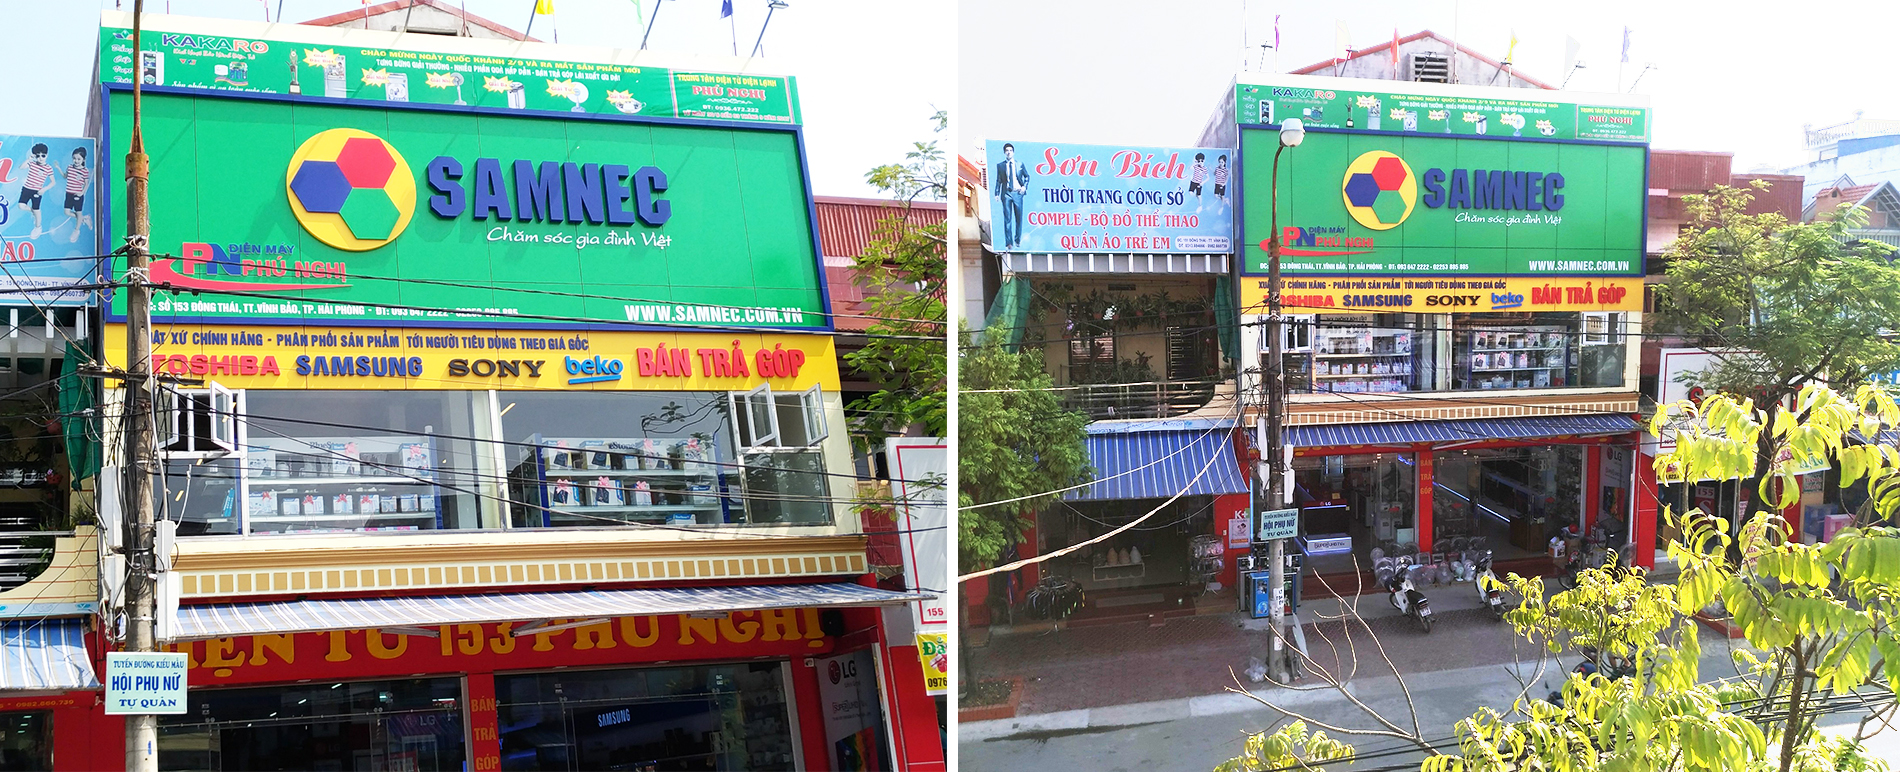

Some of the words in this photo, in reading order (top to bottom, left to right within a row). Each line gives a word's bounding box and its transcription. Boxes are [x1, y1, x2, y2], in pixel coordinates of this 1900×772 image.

[162, 34, 268, 53] KAKARO
[361, 49, 386, 57] CHÀO
[390, 50, 416, 59] MỪNG
[420, 52, 443, 61] NGÀY
[446, 53, 470, 62] QUỐC
[474, 56, 504, 64] KHÁNH
[508, 58, 523, 66] 2/9
[526, 58, 537, 66] VÀ
[555, 61, 574, 69] MẮT
[577, 62, 594, 71] SẢN
[597, 64, 621, 72] PHẨM
[624, 66, 641, 74] MỚI
[692, 84, 723, 96] PHÚ
[727, 87, 766, 101] NGHỊ
[1272, 87, 1336, 100] KAKARO
[715, 105, 759, 113] 0936.472.222
[1609, 117, 1632, 125] NGHỊ
[1036, 147, 1100, 176] Sơn
[1111, 150, 1187, 180] Bích
[428, 156, 672, 227] SAMNEC
[1042, 185, 1074, 203] THỜI
[1078, 189, 1122, 204] TRANG
[1127, 187, 1162, 205] CÔNG
[1166, 187, 1184, 205] SỞ
[1424, 168, 1564, 211] SAMNEC
[1028, 212, 1081, 226] COMPLE
[1090, 211, 1109, 229] BỘ
[1112, 210, 1131, 227] ĐỒ
[1136, 209, 1160, 227] THỂ
[1163, 214, 1199, 228] THAO
[1455, 212, 1485, 223] Chăm
[1488, 215, 1504, 224] sóc
[1506, 216, 1520, 226] gia
[1522, 215, 1541, 224] đình
[1544, 215, 1562, 226] Việt
[487, 227, 539, 243] Chăm
[543, 230, 573, 245] sóc
[577, 233, 599, 250] gia
[603, 231, 636, 246] đình
[640, 232, 672, 250] Việt
[1283, 226, 1316, 247] PN
[1309, 226, 1327, 234] ĐIỆN
[229, 242, 261, 255] ĐIỆN
[266, 242, 295, 255] MÁY
[1061, 230, 1100, 249] QUẦN
[1102, 232, 1120, 249] ÁO
[1125, 233, 1148, 249] TRẺ
[1153, 237, 1170, 249] EM
[1316, 234, 1340, 247] PHÚ
[1345, 237, 1373, 250] NGHỊ
[182, 242, 241, 276] PN
[1529, 260, 1629, 271] WWW.SAMNEC.COM.VN
[242, 256, 286, 277] PHÚ
[295, 261, 346, 282] NGHỊ
[1288, 280, 1307, 289] CHÍNH
[1309, 281, 1326, 289] HÃNG
[1333, 281, 1350, 289] PHÂN
[1352, 279, 1367, 289] PHỐI
[1368, 280, 1381, 289] SẢN
[1383, 278, 1400, 289] PHẨM
[1405, 280, 1413, 289] TỚI
[1415, 280, 1433, 289] NGƯỜI
[1435, 280, 1448, 289] TIÊU
[1450, 281, 1466, 289] DÙNG
[1483, 281, 1493, 289] GIÁ
[1495, 279, 1506, 289] GỐC
[1343, 295, 1412, 307] SAMSUNG
[1426, 295, 1481, 306] SONY
[1491, 292, 1524, 304] beko
[1532, 284, 1562, 304] BÁN
[1566, 282, 1594, 304] TRẢ
[1598, 283, 1626, 304] GÓP
[158, 298, 170, 311] SỐ
[174, 302, 189, 311] 153
[191, 300, 216, 312] ĐÔNG
[218, 299, 241, 314] THÁI,
[243, 301, 278, 314] TT.VĨNH
[281, 301, 300, 314] BẢO,
[302, 304, 316, 314] TP.
[318, 302, 334, 314] HẢI
[336, 303, 365, 315] PHÒNG
[376, 307, 390, 315] ĐT:
[625, 305, 803, 323] WWW.SAMNEC.COM.VN
[171, 330, 187, 345] XỨ
[193, 330, 226, 345] CHÍNH
[232, 331, 263, 346] HÃNG
[277, 332, 308, 347] PHÂN
[312, 330, 337, 347] PHỐI
[341, 332, 364, 347] SẢN
[368, 330, 399, 348] PHẨM
[406, 333, 423, 348] TỚI
[426, 334, 459, 348] NGƯỜI
[462, 335, 484, 349] TIÊU
[488, 334, 516, 349] DÙNG
[520, 337, 546, 349] THEO
[548, 336, 566, 350] GIÁ
[568, 334, 589, 350] GỐC
[152, 354, 280, 376] TOSHIBA
[296, 355, 422, 377] SAMSUNG
[448, 359, 545, 377] SONY
[565, 355, 623, 375] beko
[636, 342, 692, 377] BÁN
[697, 339, 750, 377] TRẢ
[756, 343, 805, 378] GÓP
[1614, 451, 1622, 461] LG
[1697, 488, 1714, 496] 155
[1235, 510, 1248, 519] K+
[1264, 522, 1273, 532] HỘI
[1274, 521, 1285, 530] PHỤ
[926, 607, 944, 617] 155
[114, 658, 133, 668] TUYẾN
[134, 659, 154, 668] ĐƯỜNG
[156, 658, 170, 668] KIỂU
[171, 657, 184, 668] MẪU
[842, 660, 857, 678] LG
[112, 672, 132, 693] HỘI
[136, 676, 159, 693] PHỤ
[163, 672, 181, 691] NỮ
[119, 699, 137, 709] TỰ
[141, 696, 176, 708] QUẢN
[471, 694, 495, 712] BÁN
[598, 708, 631, 728] SAMSUNG
[474, 723, 497, 741] TRẢ
[476, 754, 500, 770] GÓP
